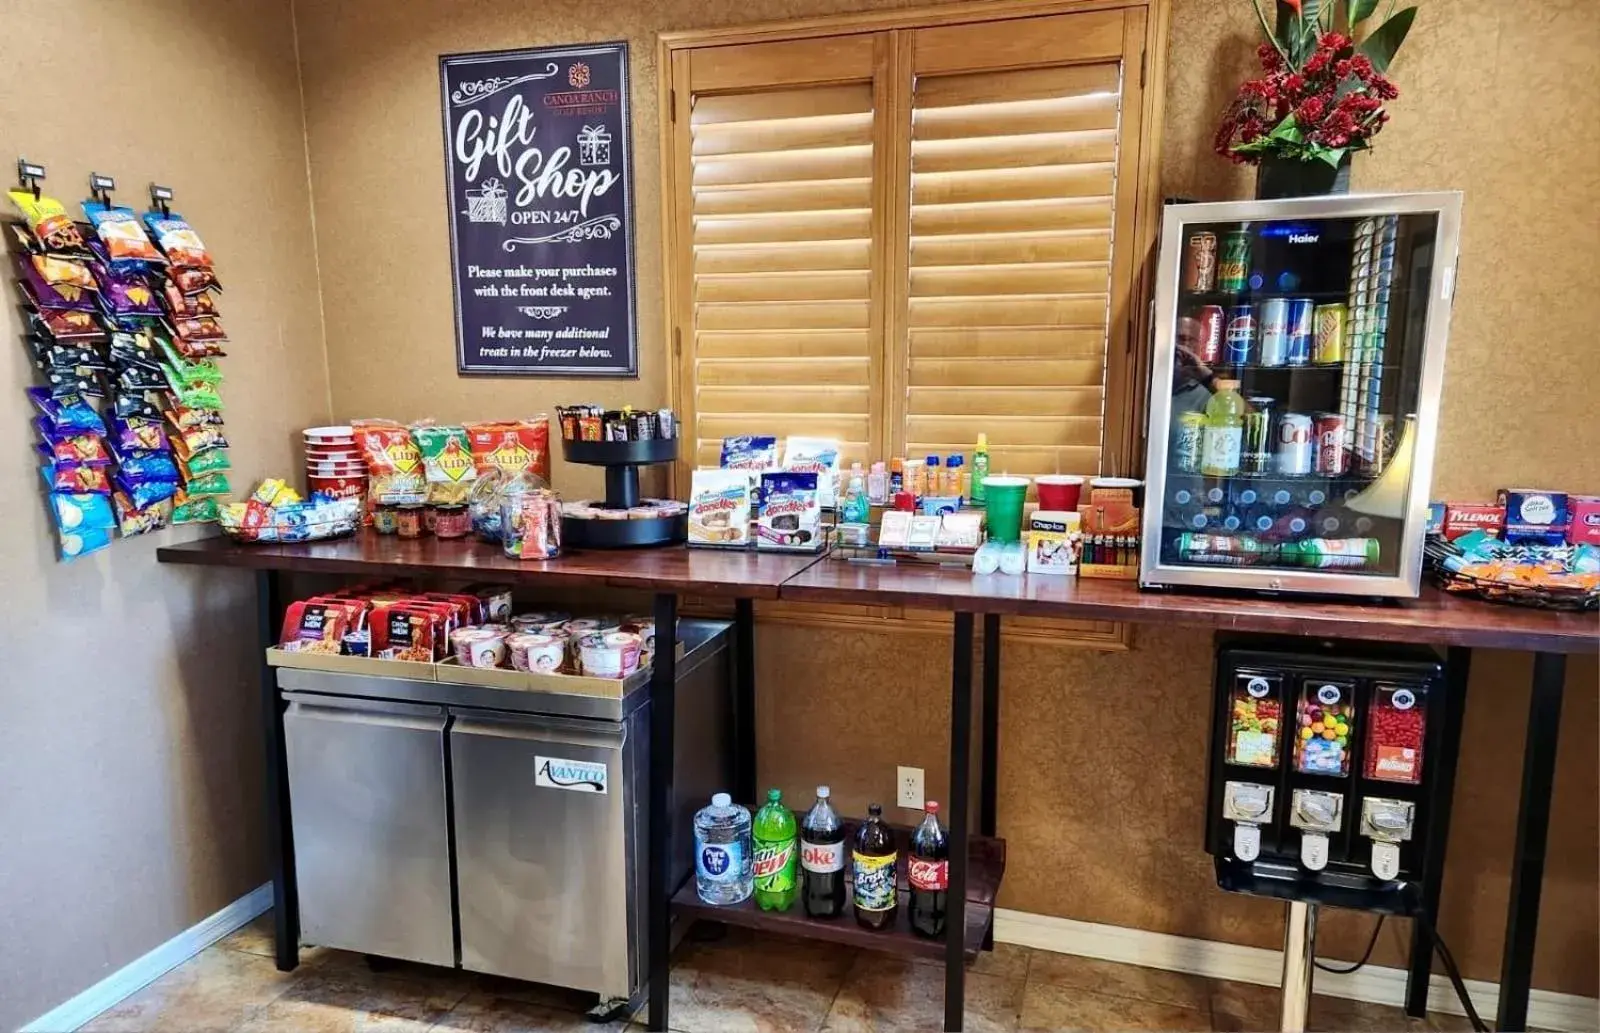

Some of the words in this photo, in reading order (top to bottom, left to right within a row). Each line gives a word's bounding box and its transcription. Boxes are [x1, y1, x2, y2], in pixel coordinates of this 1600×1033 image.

[543, 94, 580, 106] CANOA
[580, 91, 618, 104] RANCH
[456, 94, 536, 182] Gift
[515, 147, 620, 218] Shop
[511, 211, 550, 225] OPEN
[553, 210, 579, 224] 24/7
[1289, 234, 1319, 244] Haier
[467, 265, 502, 278] Please
[504, 265, 533, 277] make
[535, 267, 559, 280] your
[562, 264, 617, 280] purchases
[474, 285, 499, 297] with
[501, 284, 518, 296] the
[520, 283, 549, 296] front
[550, 283, 576, 296] desk
[577, 285, 612, 299] agent.
[481, 327, 496, 338] We
[497, 326, 523, 338] have
[525, 329, 554, 342] many
[555, 326, 610, 339] additional
[479, 347, 508, 357] treats
[510, 346, 521, 357] in
[522, 346, 538, 357] the
[538, 347, 577, 361] freezer
[579, 346, 612, 358] below.
[695, 498, 737, 514] donettes
[765, 499, 808, 517] donettes
[1449, 510, 1501, 523] TYLENOL
[538, 760, 604, 784] AVANTCO
[802, 848, 835, 864] oke
[858, 869, 885, 884] Brisk
[911, 861, 938, 882] Cola
